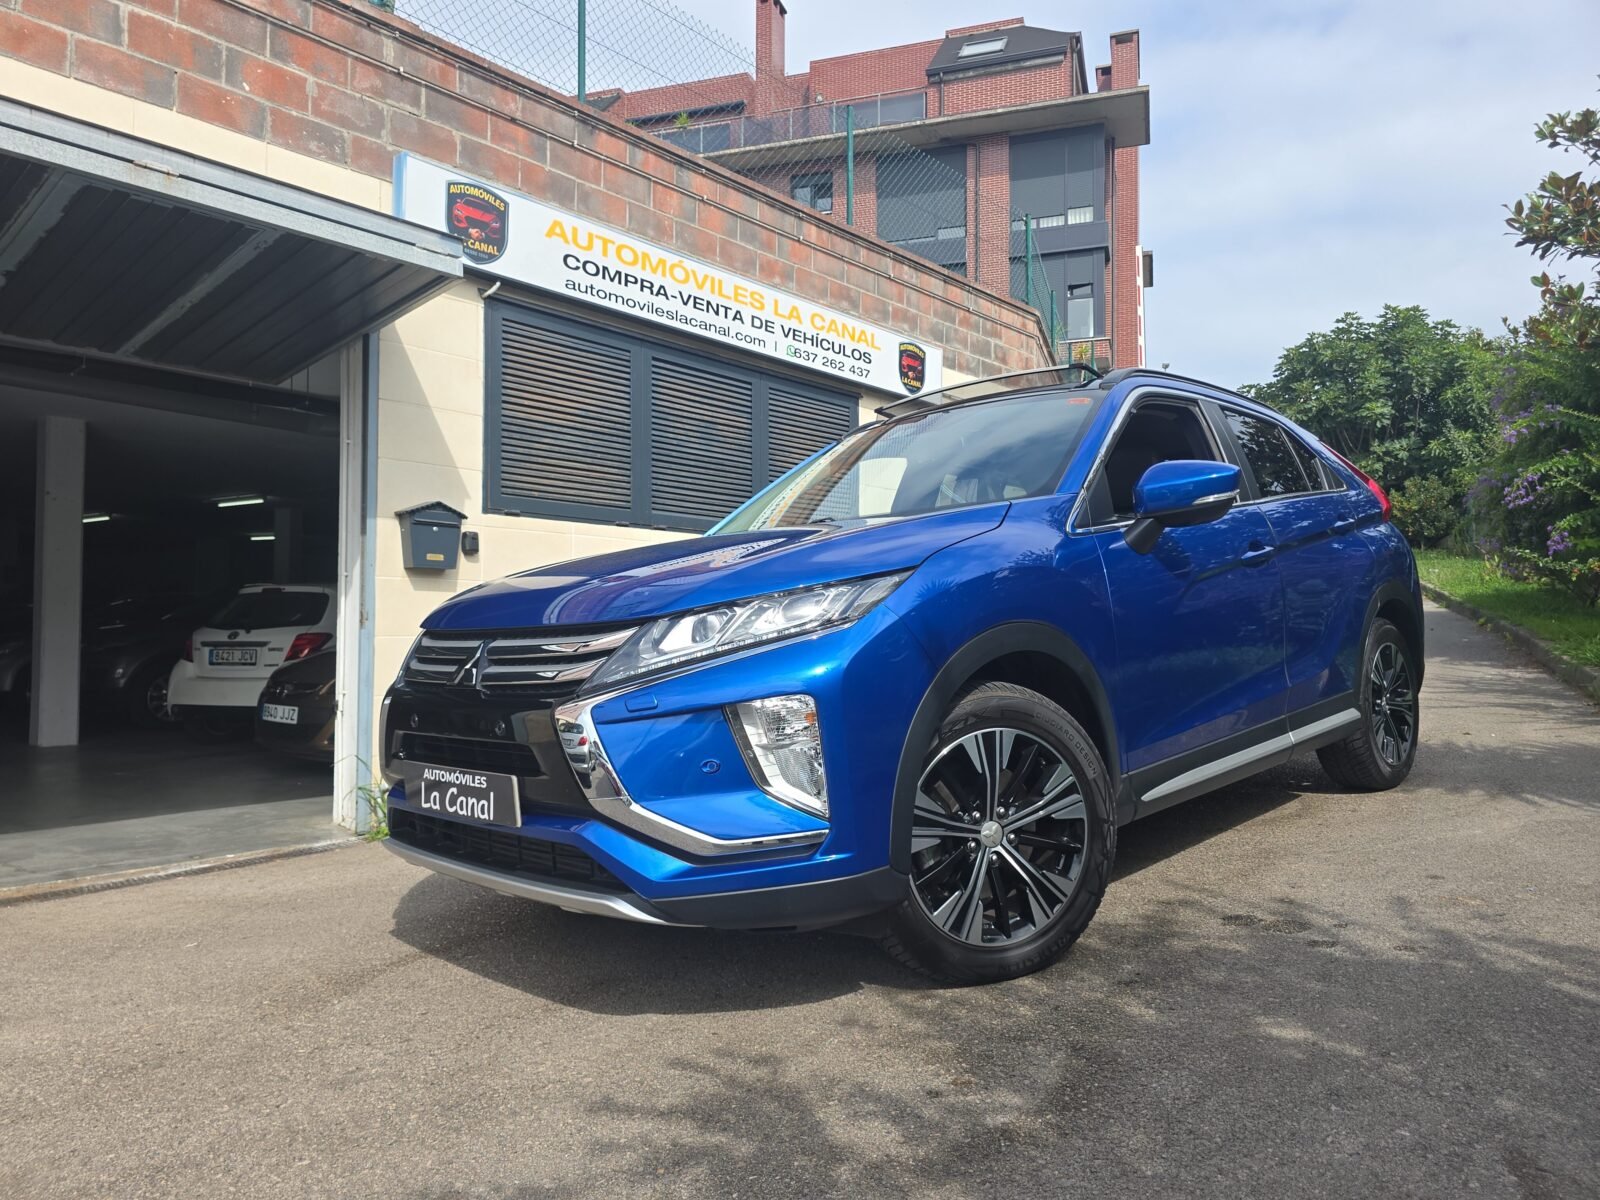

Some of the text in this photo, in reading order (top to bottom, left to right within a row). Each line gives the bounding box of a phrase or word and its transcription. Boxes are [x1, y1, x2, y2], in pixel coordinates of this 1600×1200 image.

[449, 184, 505, 211] AUTOMÓVILES
[468, 239, 499, 256] CANAL
[545, 219, 881, 350] AUTOMÓVILES LA CANAL
[563, 253, 873, 364] COMPRA-VENTA DE VEHÍCULOS
[565, 279, 766, 348] automovileslacanal.com
[794, 349, 870, 379] 637 262 437
[214, 651, 255, 661] 8421 JCV
[280, 707, 296, 721] JJZ
[1074, 741, 1098, 775] DESIGN
[423, 768, 487, 788] AUTOMÓVILES
[421, 781, 494, 820] La Canal
